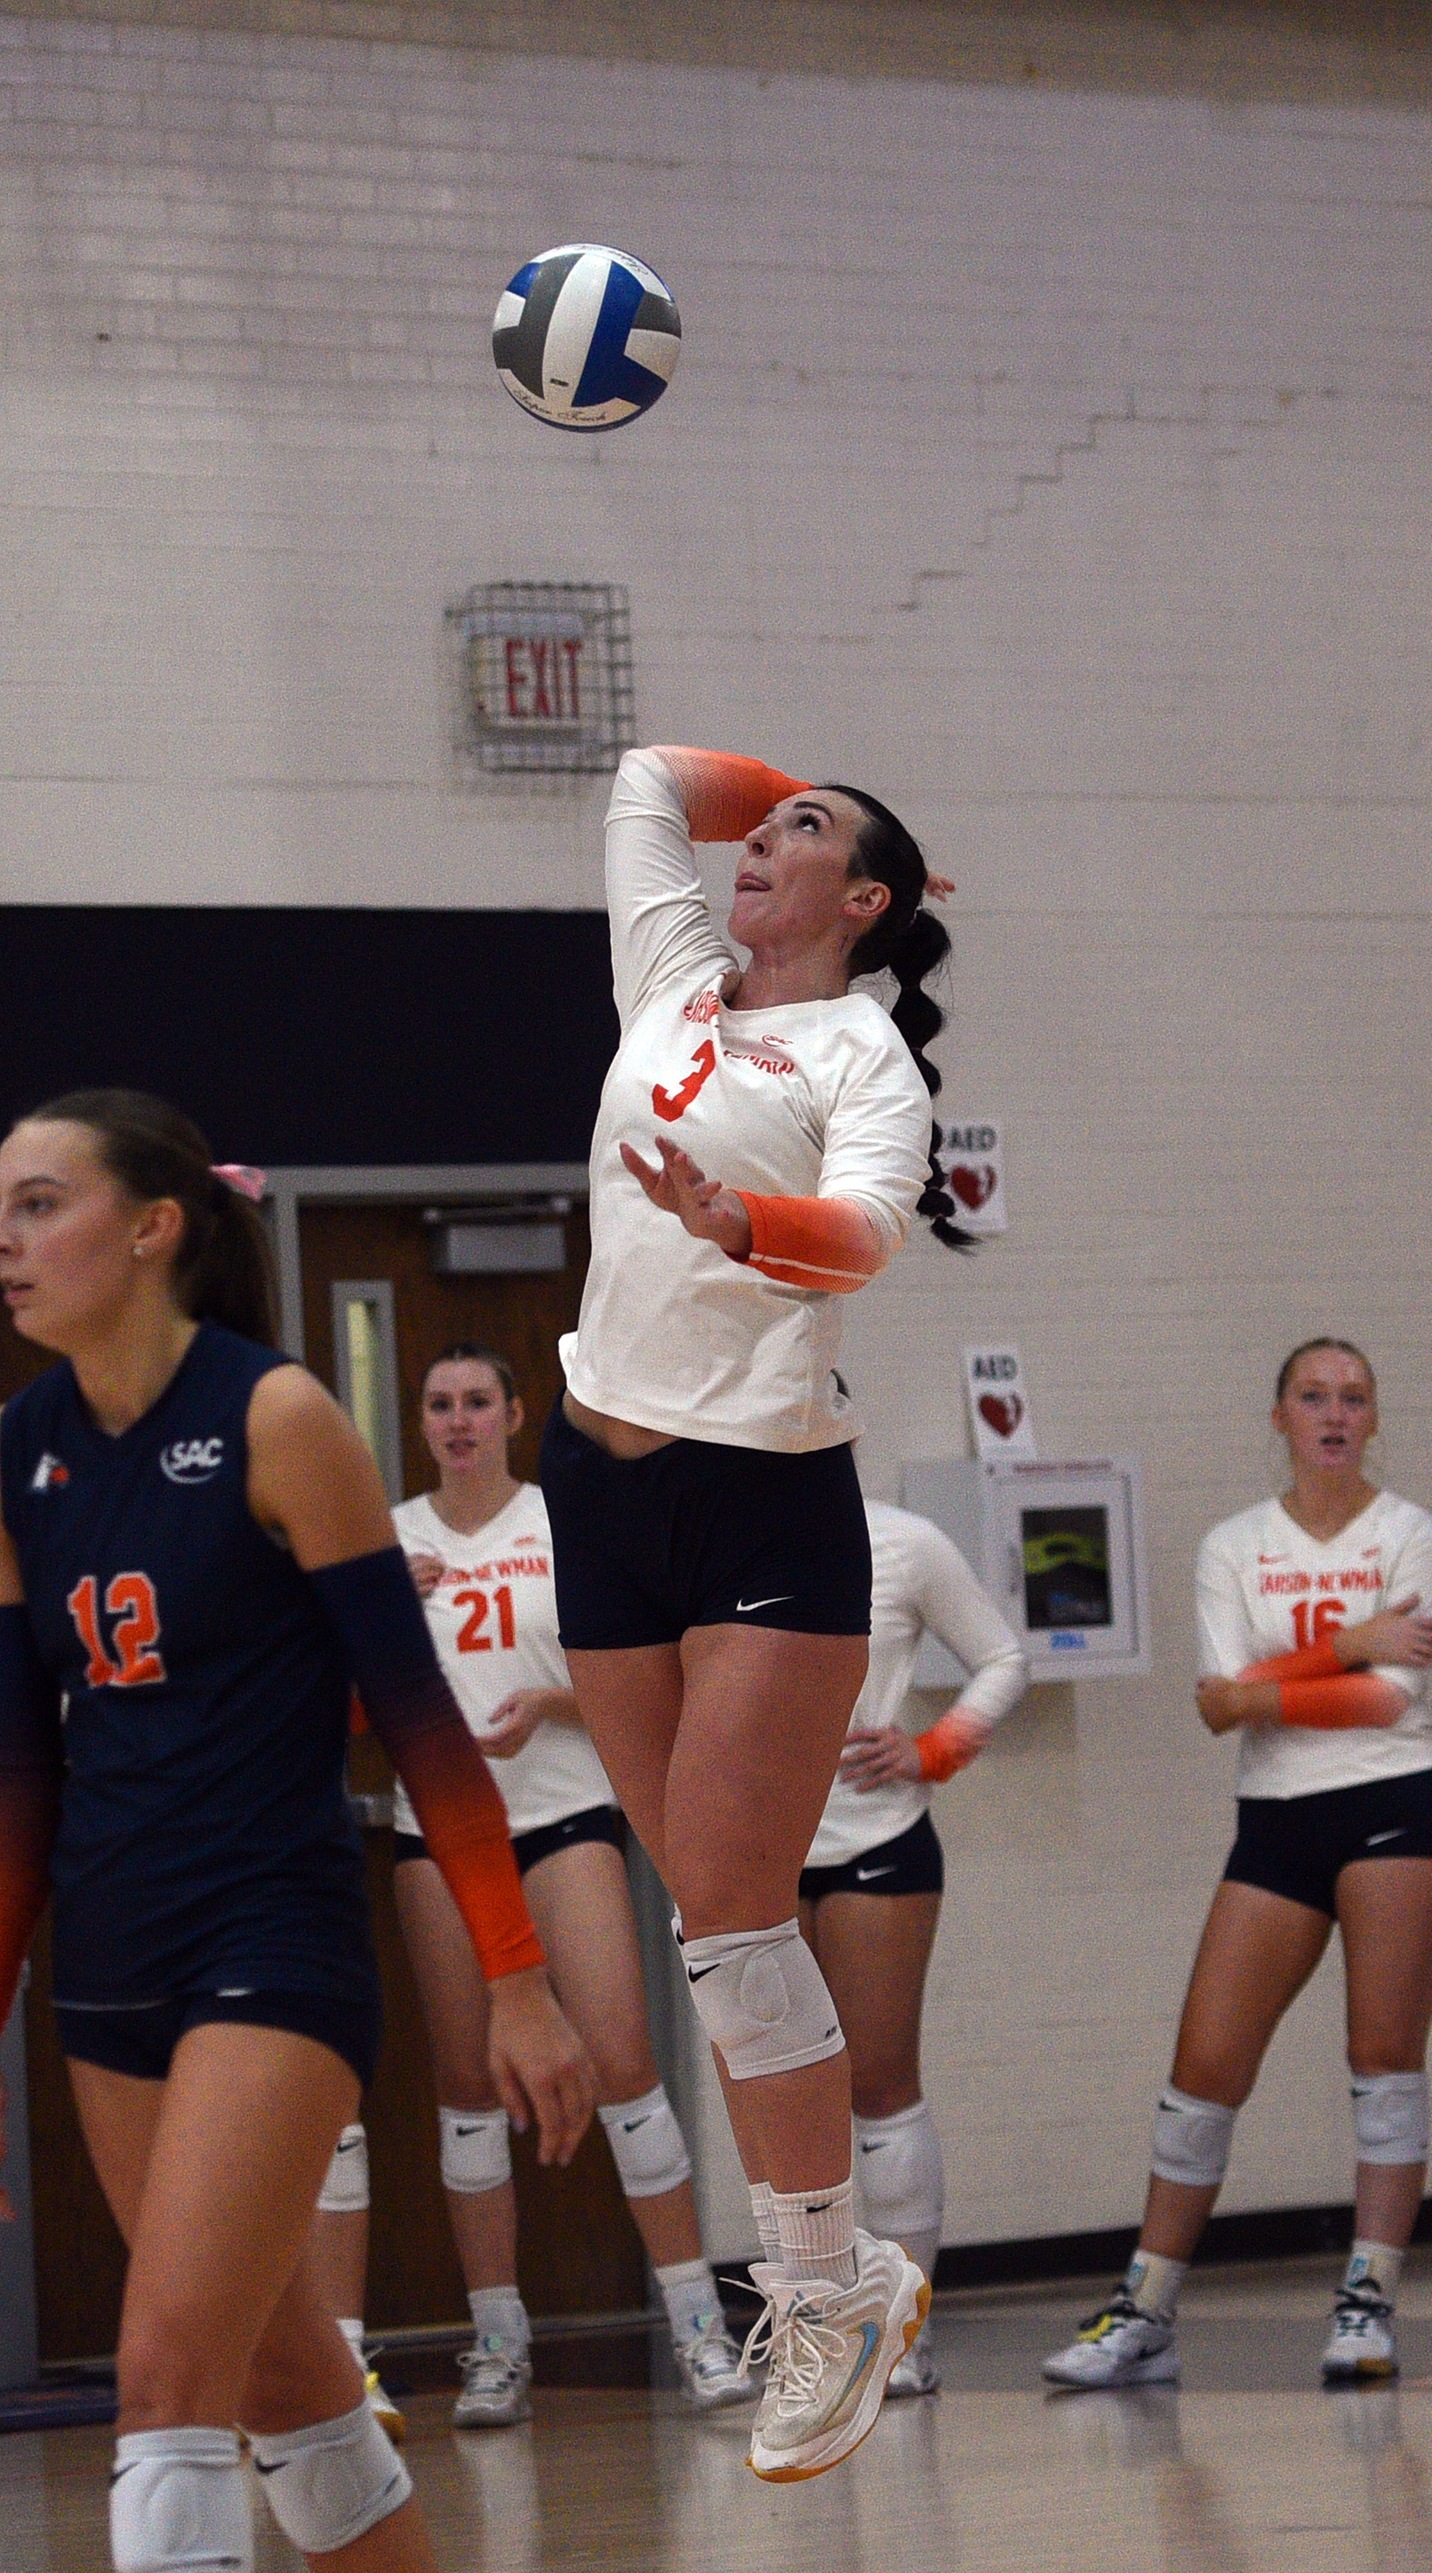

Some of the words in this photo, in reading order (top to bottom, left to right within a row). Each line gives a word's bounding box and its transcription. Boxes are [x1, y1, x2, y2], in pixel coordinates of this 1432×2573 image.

[505, 637, 583, 719] EXIT
[652, 1039, 716, 1123] 3
[948, 1126, 997, 1151] AED
[972, 1355, 1019, 1381] AED
[170, 1437, 224, 1471] SAC
[67, 1571, 166, 1688] 12
[452, 1585, 516, 1654] 21
[1291, 1598, 1346, 1651] 16
